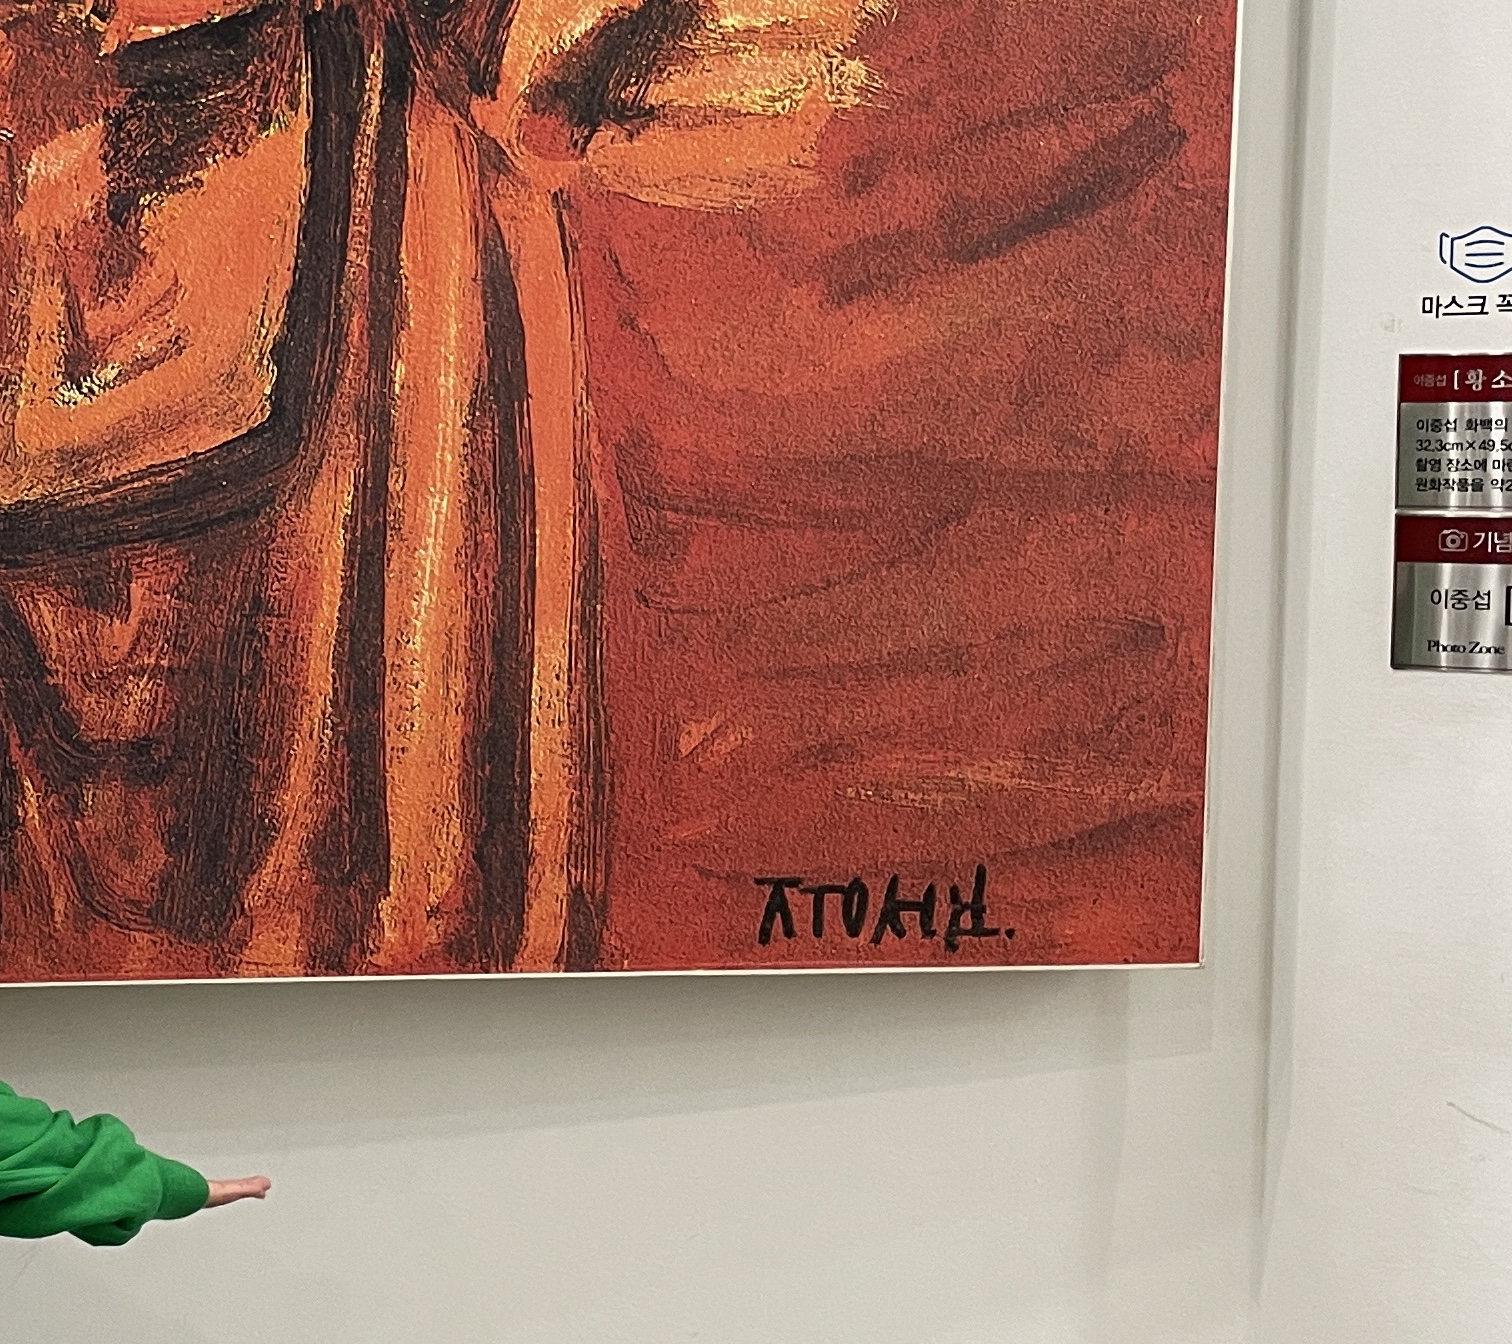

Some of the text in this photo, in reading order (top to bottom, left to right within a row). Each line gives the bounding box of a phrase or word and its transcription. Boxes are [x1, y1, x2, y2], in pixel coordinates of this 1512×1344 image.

[1421, 294, 1489, 319] 마스크
[1416, 417, 1458, 433] 이중섭
[1446, 457, 1487, 473] 장소에
[1430, 588, 1491, 611] 이중섭
[1426, 639, 1506, 655] Photo Zone
